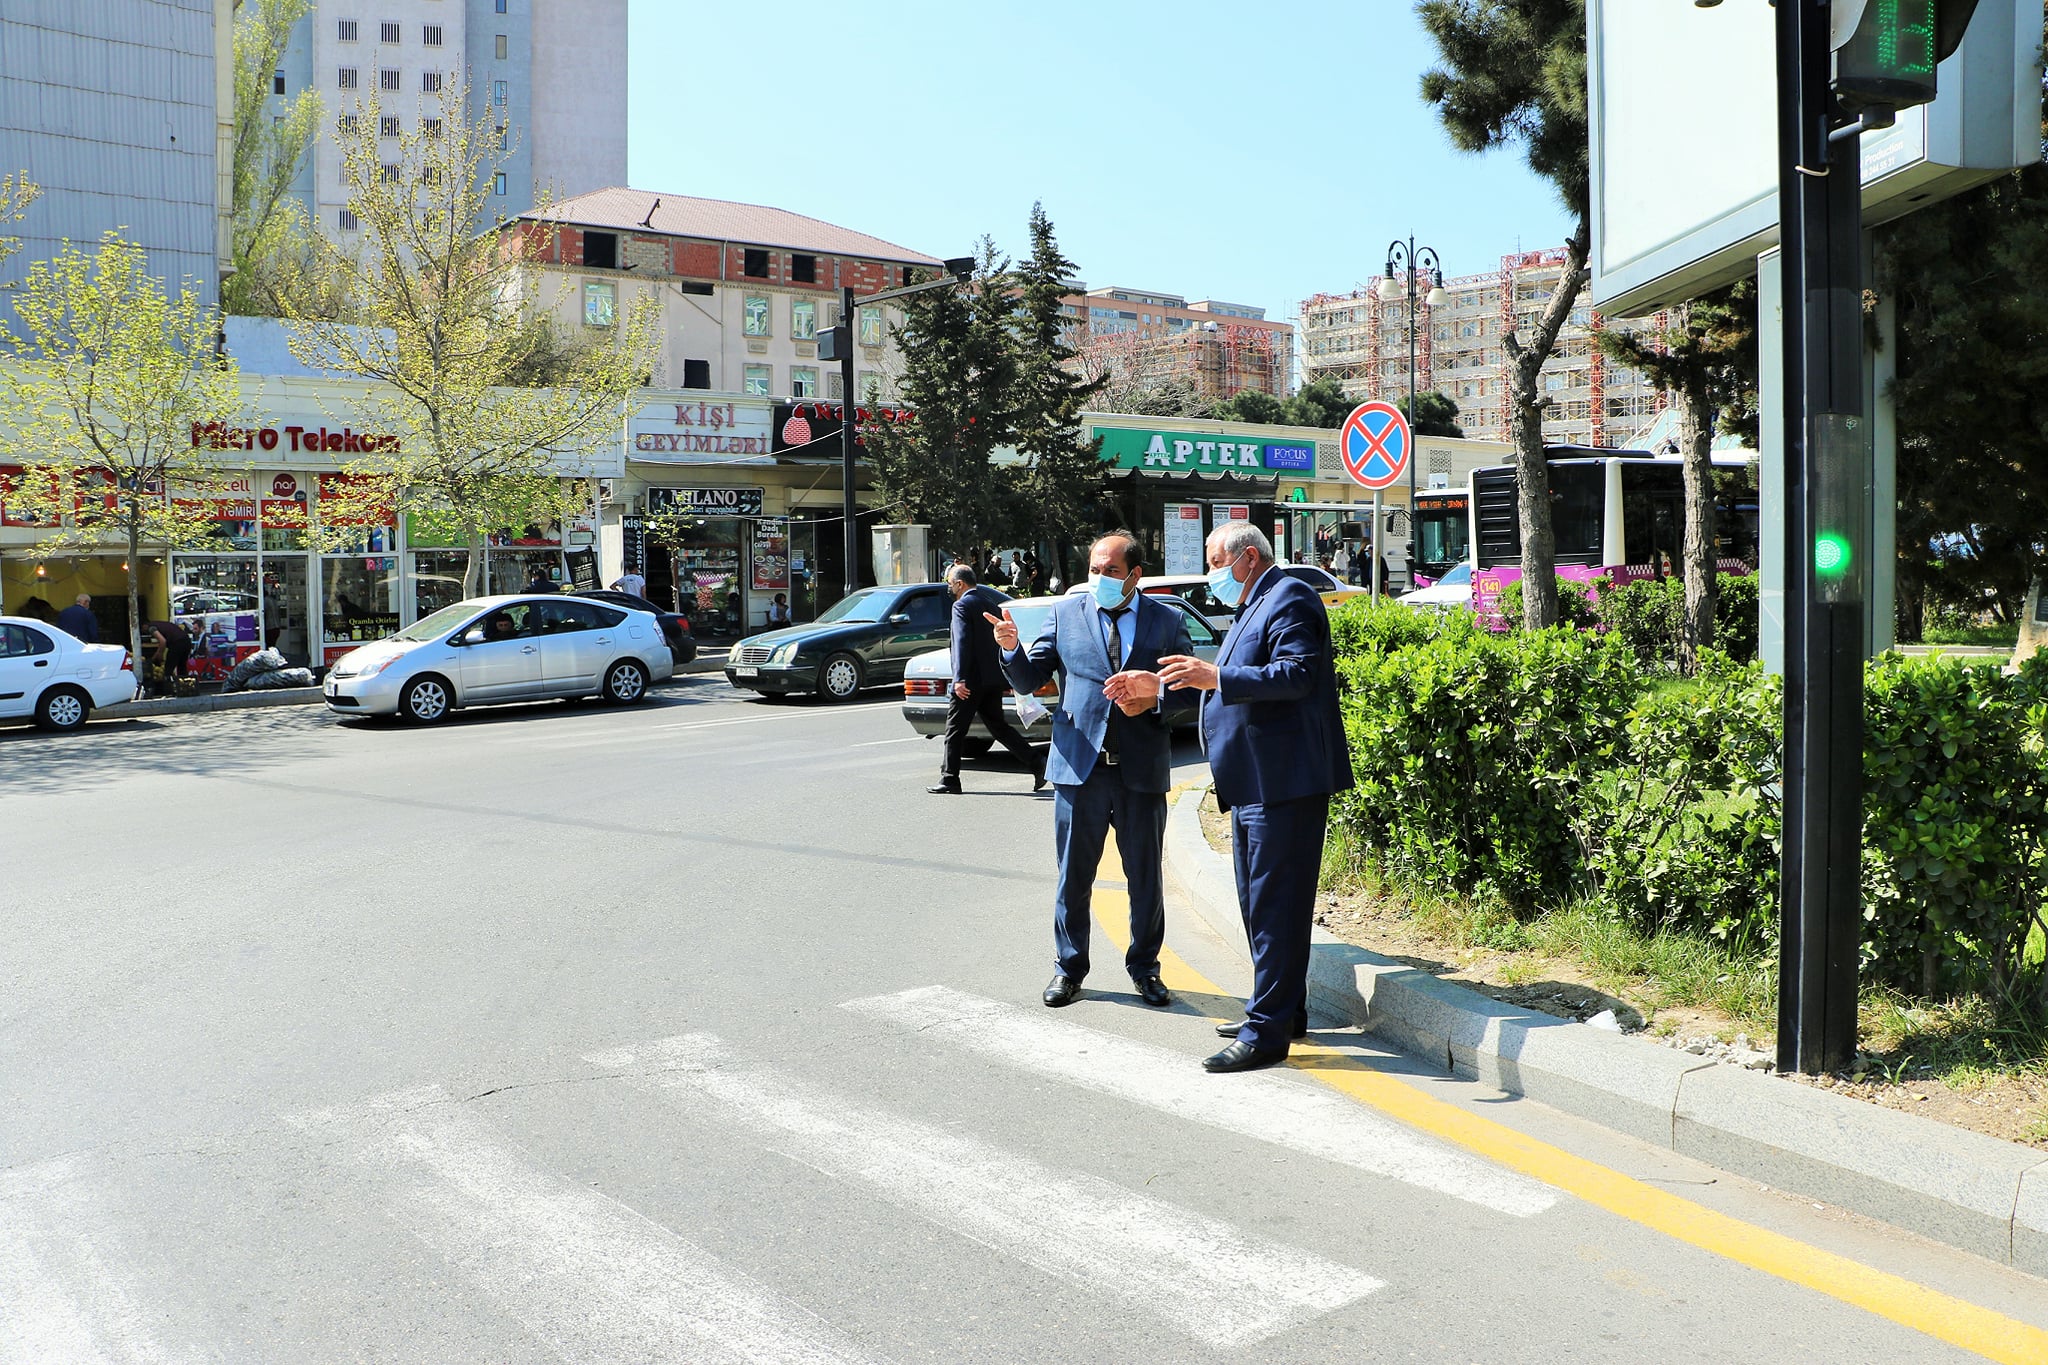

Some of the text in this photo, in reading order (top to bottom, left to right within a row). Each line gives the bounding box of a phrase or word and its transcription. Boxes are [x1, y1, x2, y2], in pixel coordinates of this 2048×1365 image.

[675, 401, 735, 431] KİŞİ
[284, 426, 401, 453] Telekom
[636, 428, 768, 455] GEYİMLƏRİ
[1144, 434, 1259, 467] APTEK
[1274, 448, 1307, 460] FOCUS
[274, 481, 296, 490] nar
[1485, 582, 1499, 592] 141
[348, 617, 375, 626] Qramla
